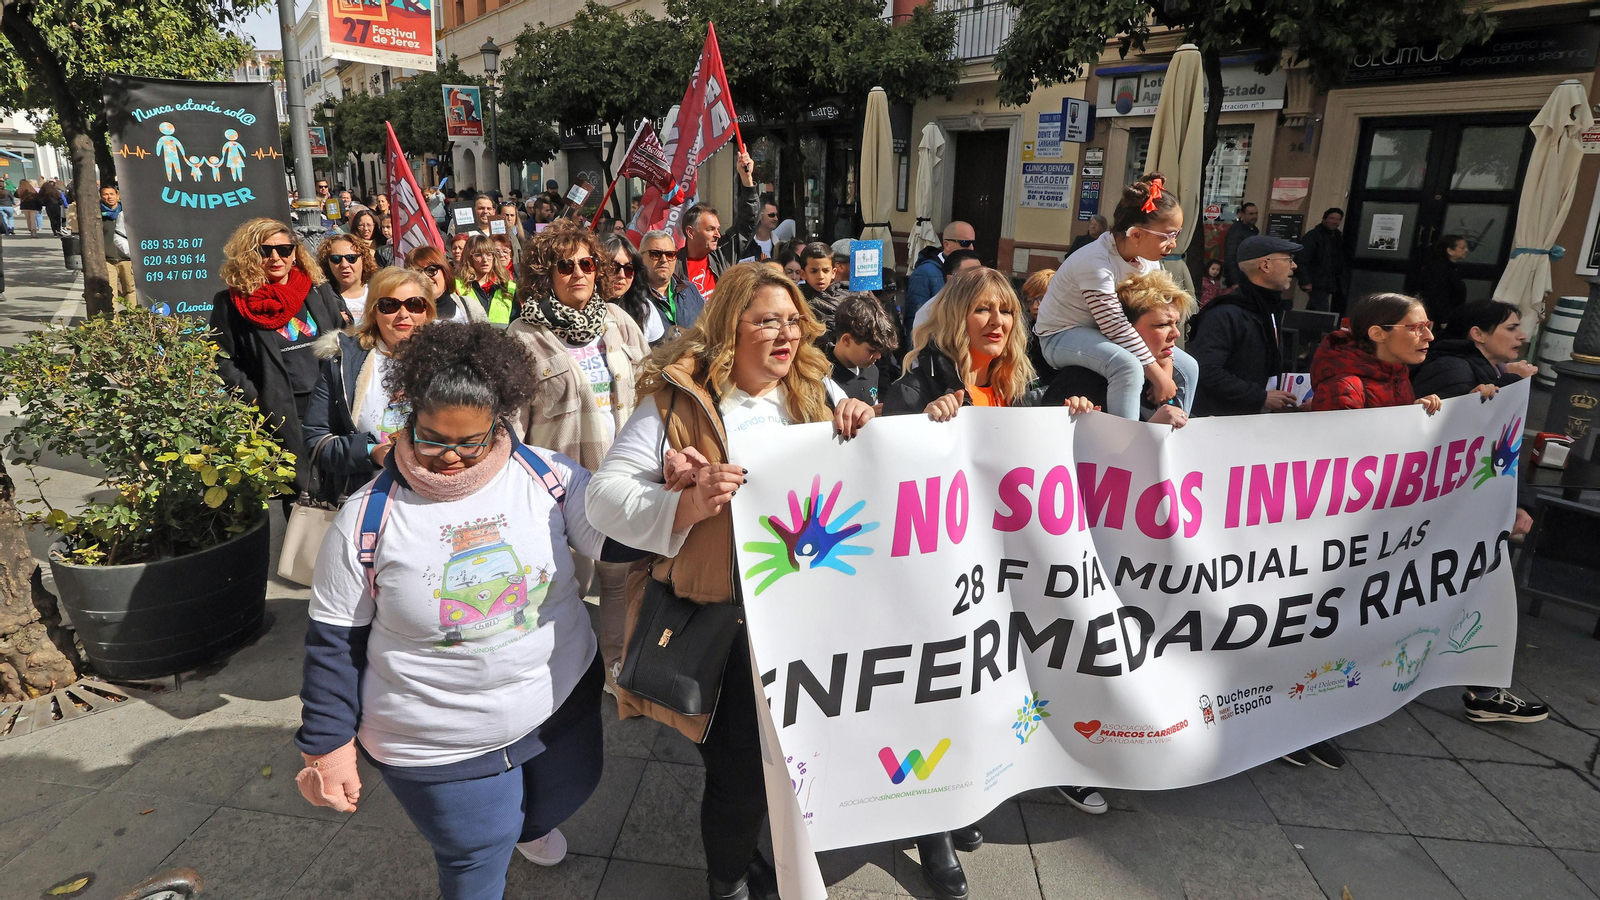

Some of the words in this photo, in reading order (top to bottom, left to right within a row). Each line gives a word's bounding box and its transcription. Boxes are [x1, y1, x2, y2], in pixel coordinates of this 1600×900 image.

[342, 17, 371, 44] 27
[372, 24, 416, 40] Festival
[372, 34, 388, 44] de
[391, 35, 420, 48] Jerez
[1222, 83, 1266, 97] Estado
[132, 104, 175, 123] Nunca
[175, 98, 222, 115] estarás
[223, 108, 257, 126] sol@
[1024, 175, 1070, 185] LARGADENT
[161, 186, 257, 209] UNIPER
[140, 239, 160, 251] 689
[162, 239, 175, 250] 35
[177, 238, 189, 249] 26
[191, 238, 204, 249] 07
[143, 255, 162, 266] 620
[164, 254, 178, 265] 43
[179, 254, 193, 265] 96
[195, 253, 206, 264] 14
[145, 271, 164, 282] 619
[166, 270, 179, 281] 47
[181, 269, 193, 280] 67
[195, 269, 208, 280] 03
[176, 301, 214, 313] Asocia
[890, 469, 969, 558] NO
[992, 462, 1203, 540] SOMOS
[1224, 435, 1485, 529] INVISIBLES
[952, 563, 985, 616] 28
[997, 558, 1029, 593] F
[1044, 550, 1106, 599] DÍA
[1114, 544, 1308, 595] MUNDIAL
[1322, 533, 1369, 572] DE
[1377, 519, 1431, 561] LAS
[1359, 529, 1511, 626] RARAS
[1318, 677, 1346, 690] Deletions
[1216, 684, 1274, 708] Duchenne
[1234, 694, 1272, 716] España
[1100, 729, 1145, 739] MARCOS
[1147, 719, 1189, 738] CARRIBERO
[1101, 723, 1155, 731] ASOCIACIÓN
[1154, 736, 1172, 745] VIVIR
[796, 761, 807, 775] de
